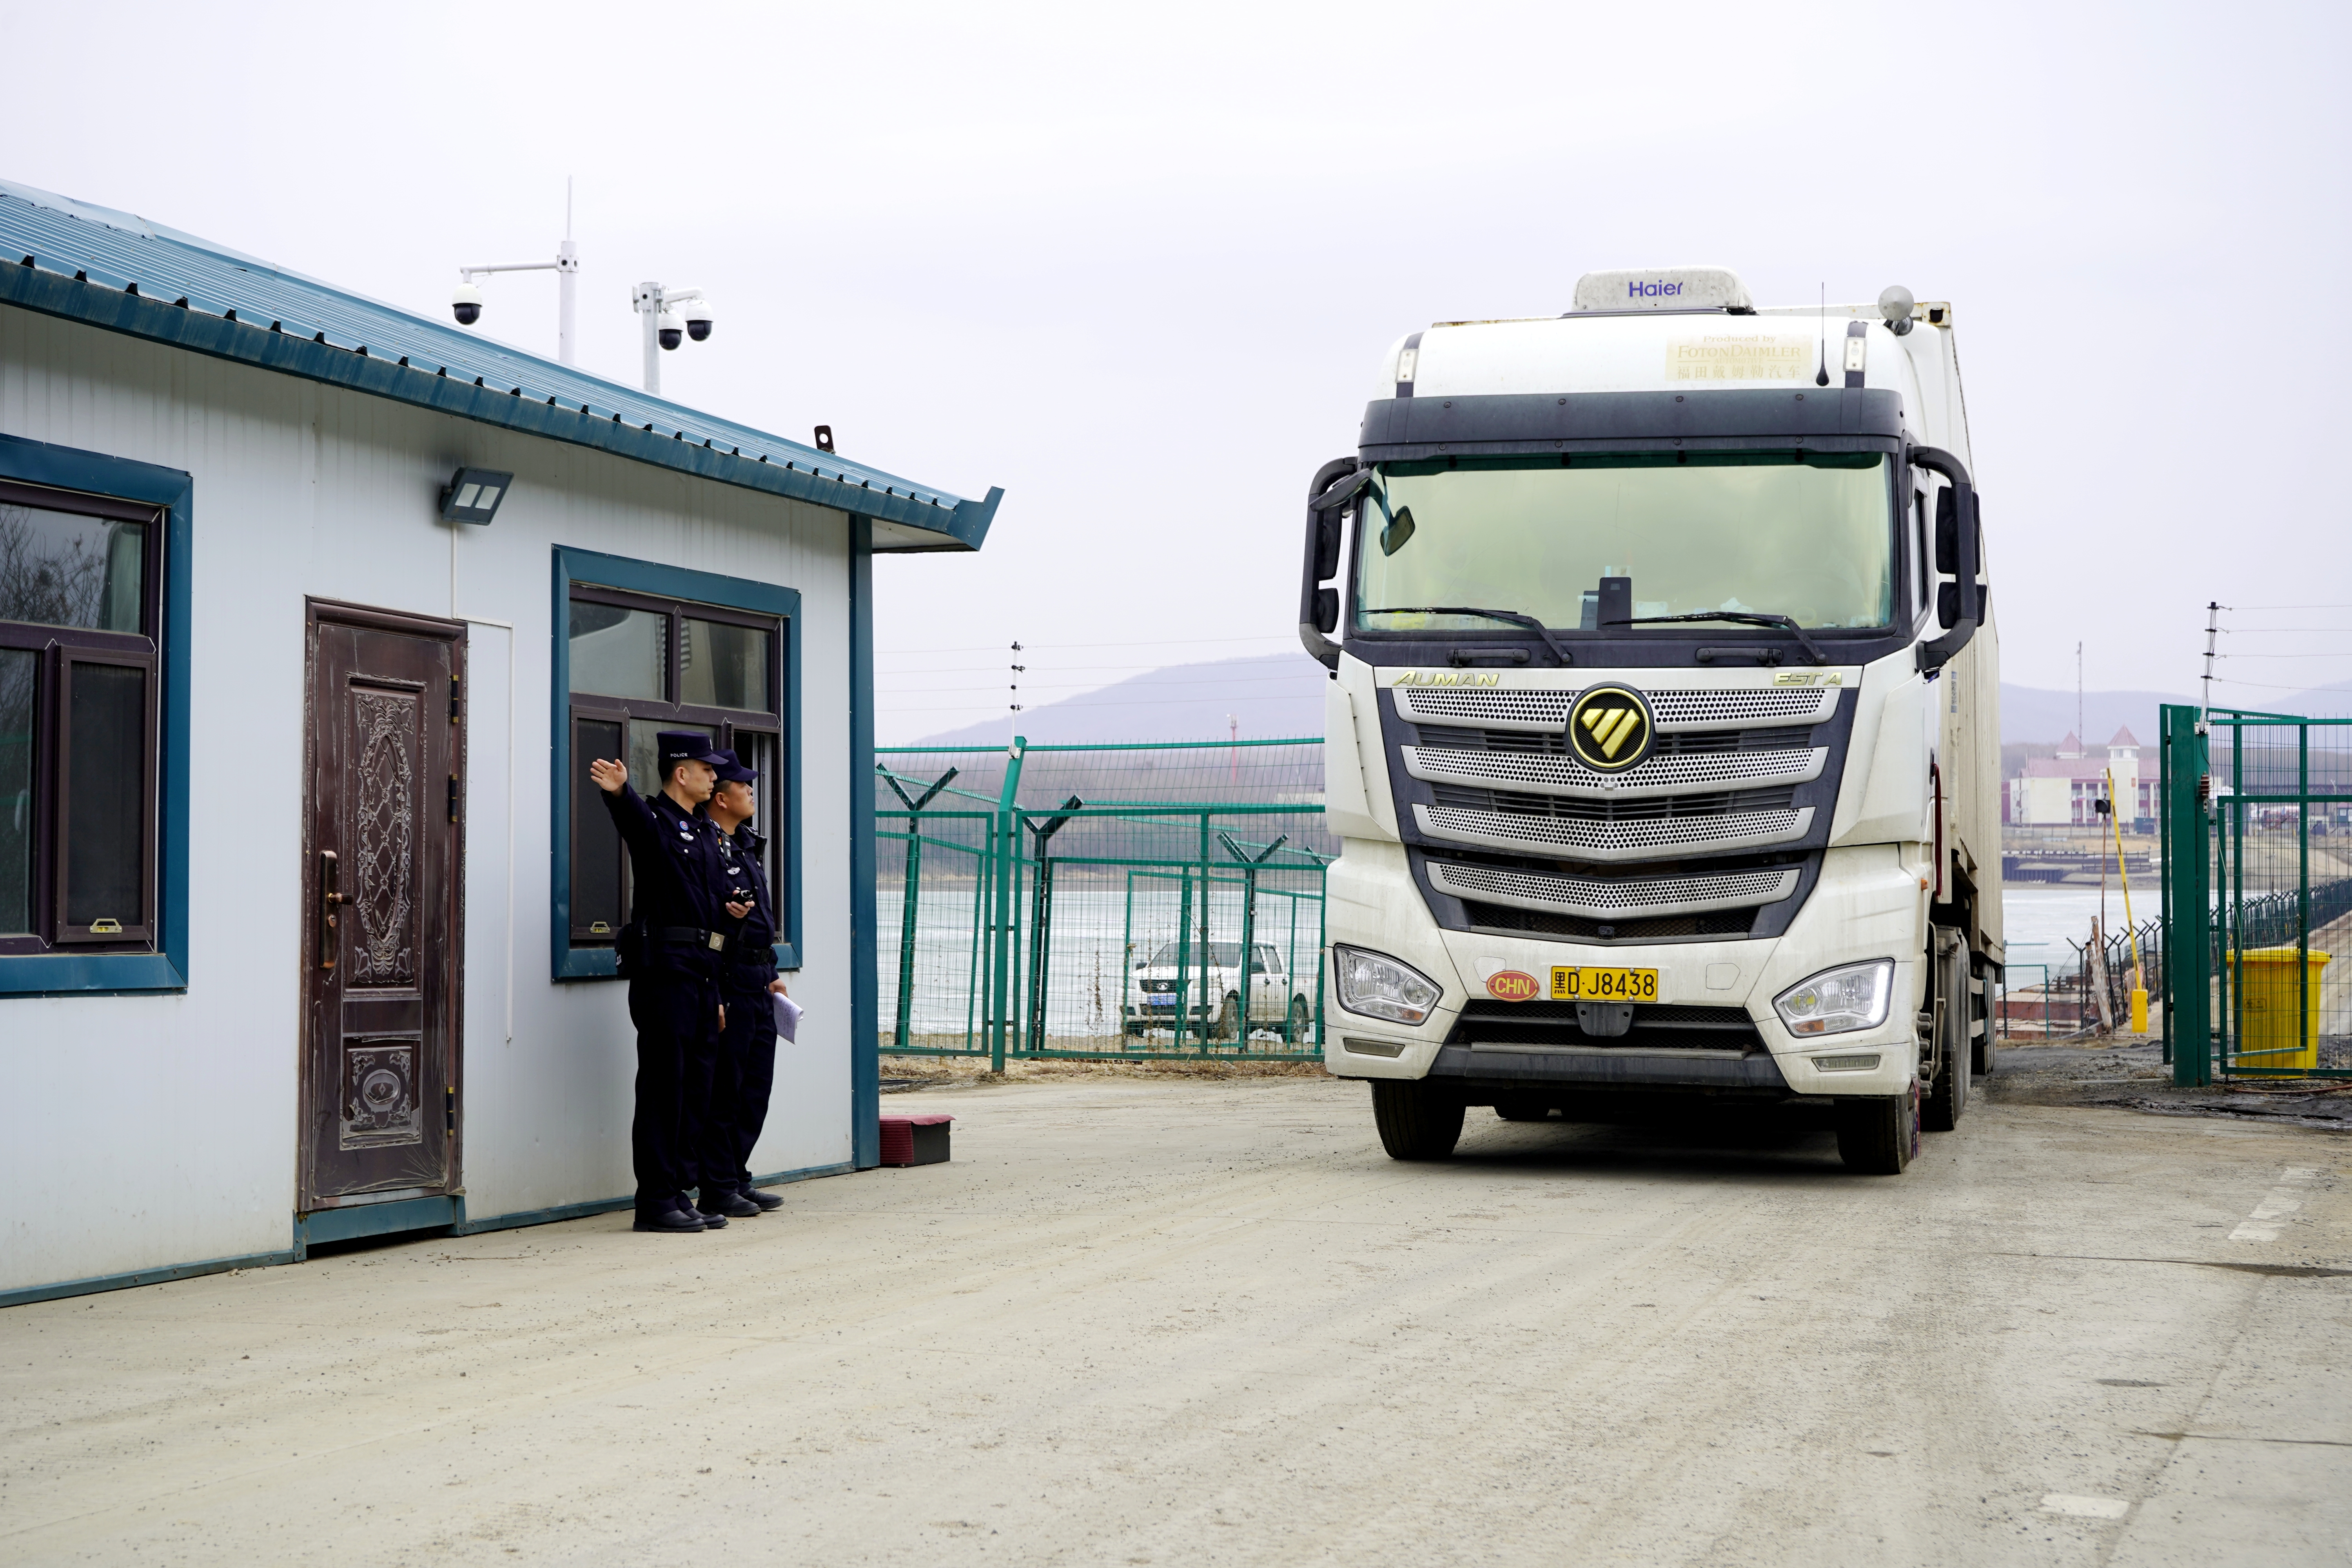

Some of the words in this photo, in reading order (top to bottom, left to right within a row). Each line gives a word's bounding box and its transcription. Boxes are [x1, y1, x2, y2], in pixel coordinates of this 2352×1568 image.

[1629, 279, 1683, 297] Haier
[1763, 335, 1776, 343] by
[1677, 365, 1800, 379] 福田戴姆勒汽车
[1392, 671, 1499, 686] AUMAN
[1495, 977, 1529, 995] CHN
